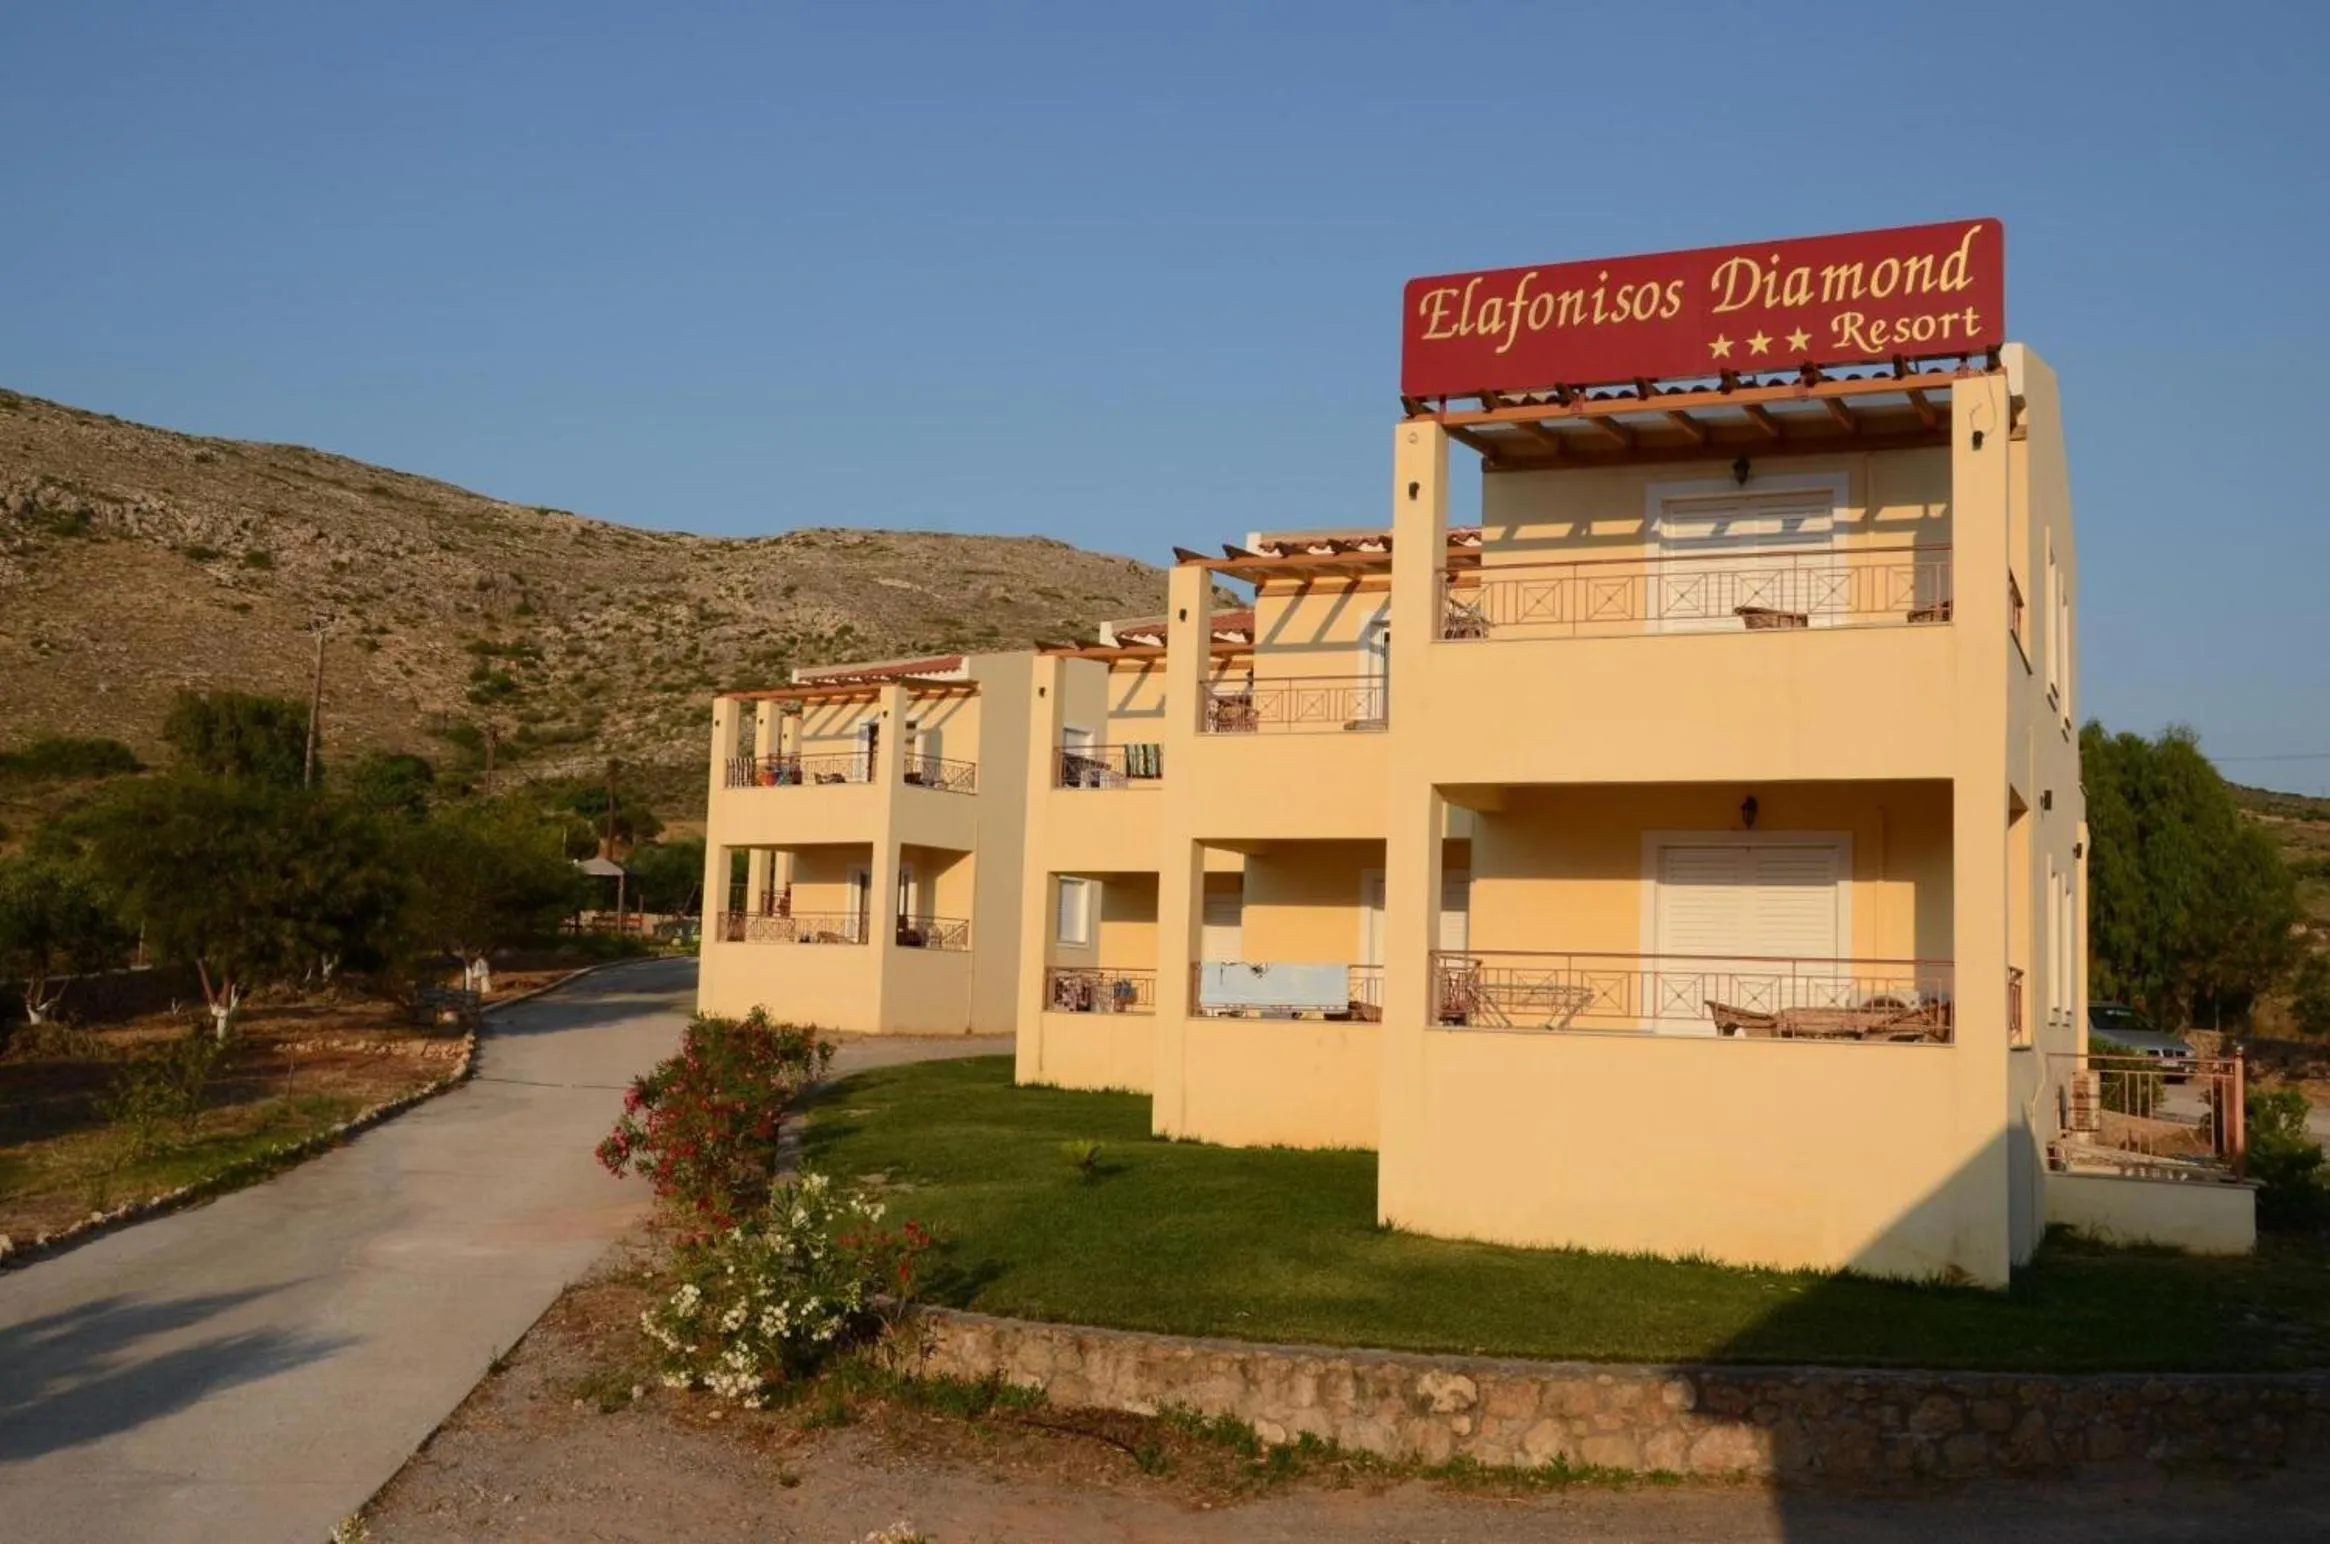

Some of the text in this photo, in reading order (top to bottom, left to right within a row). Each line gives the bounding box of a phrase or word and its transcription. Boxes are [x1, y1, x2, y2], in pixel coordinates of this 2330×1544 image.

[1418, 224, 1983, 354] Elafonisos Diamond
[1830, 305, 1982, 354] Resort
